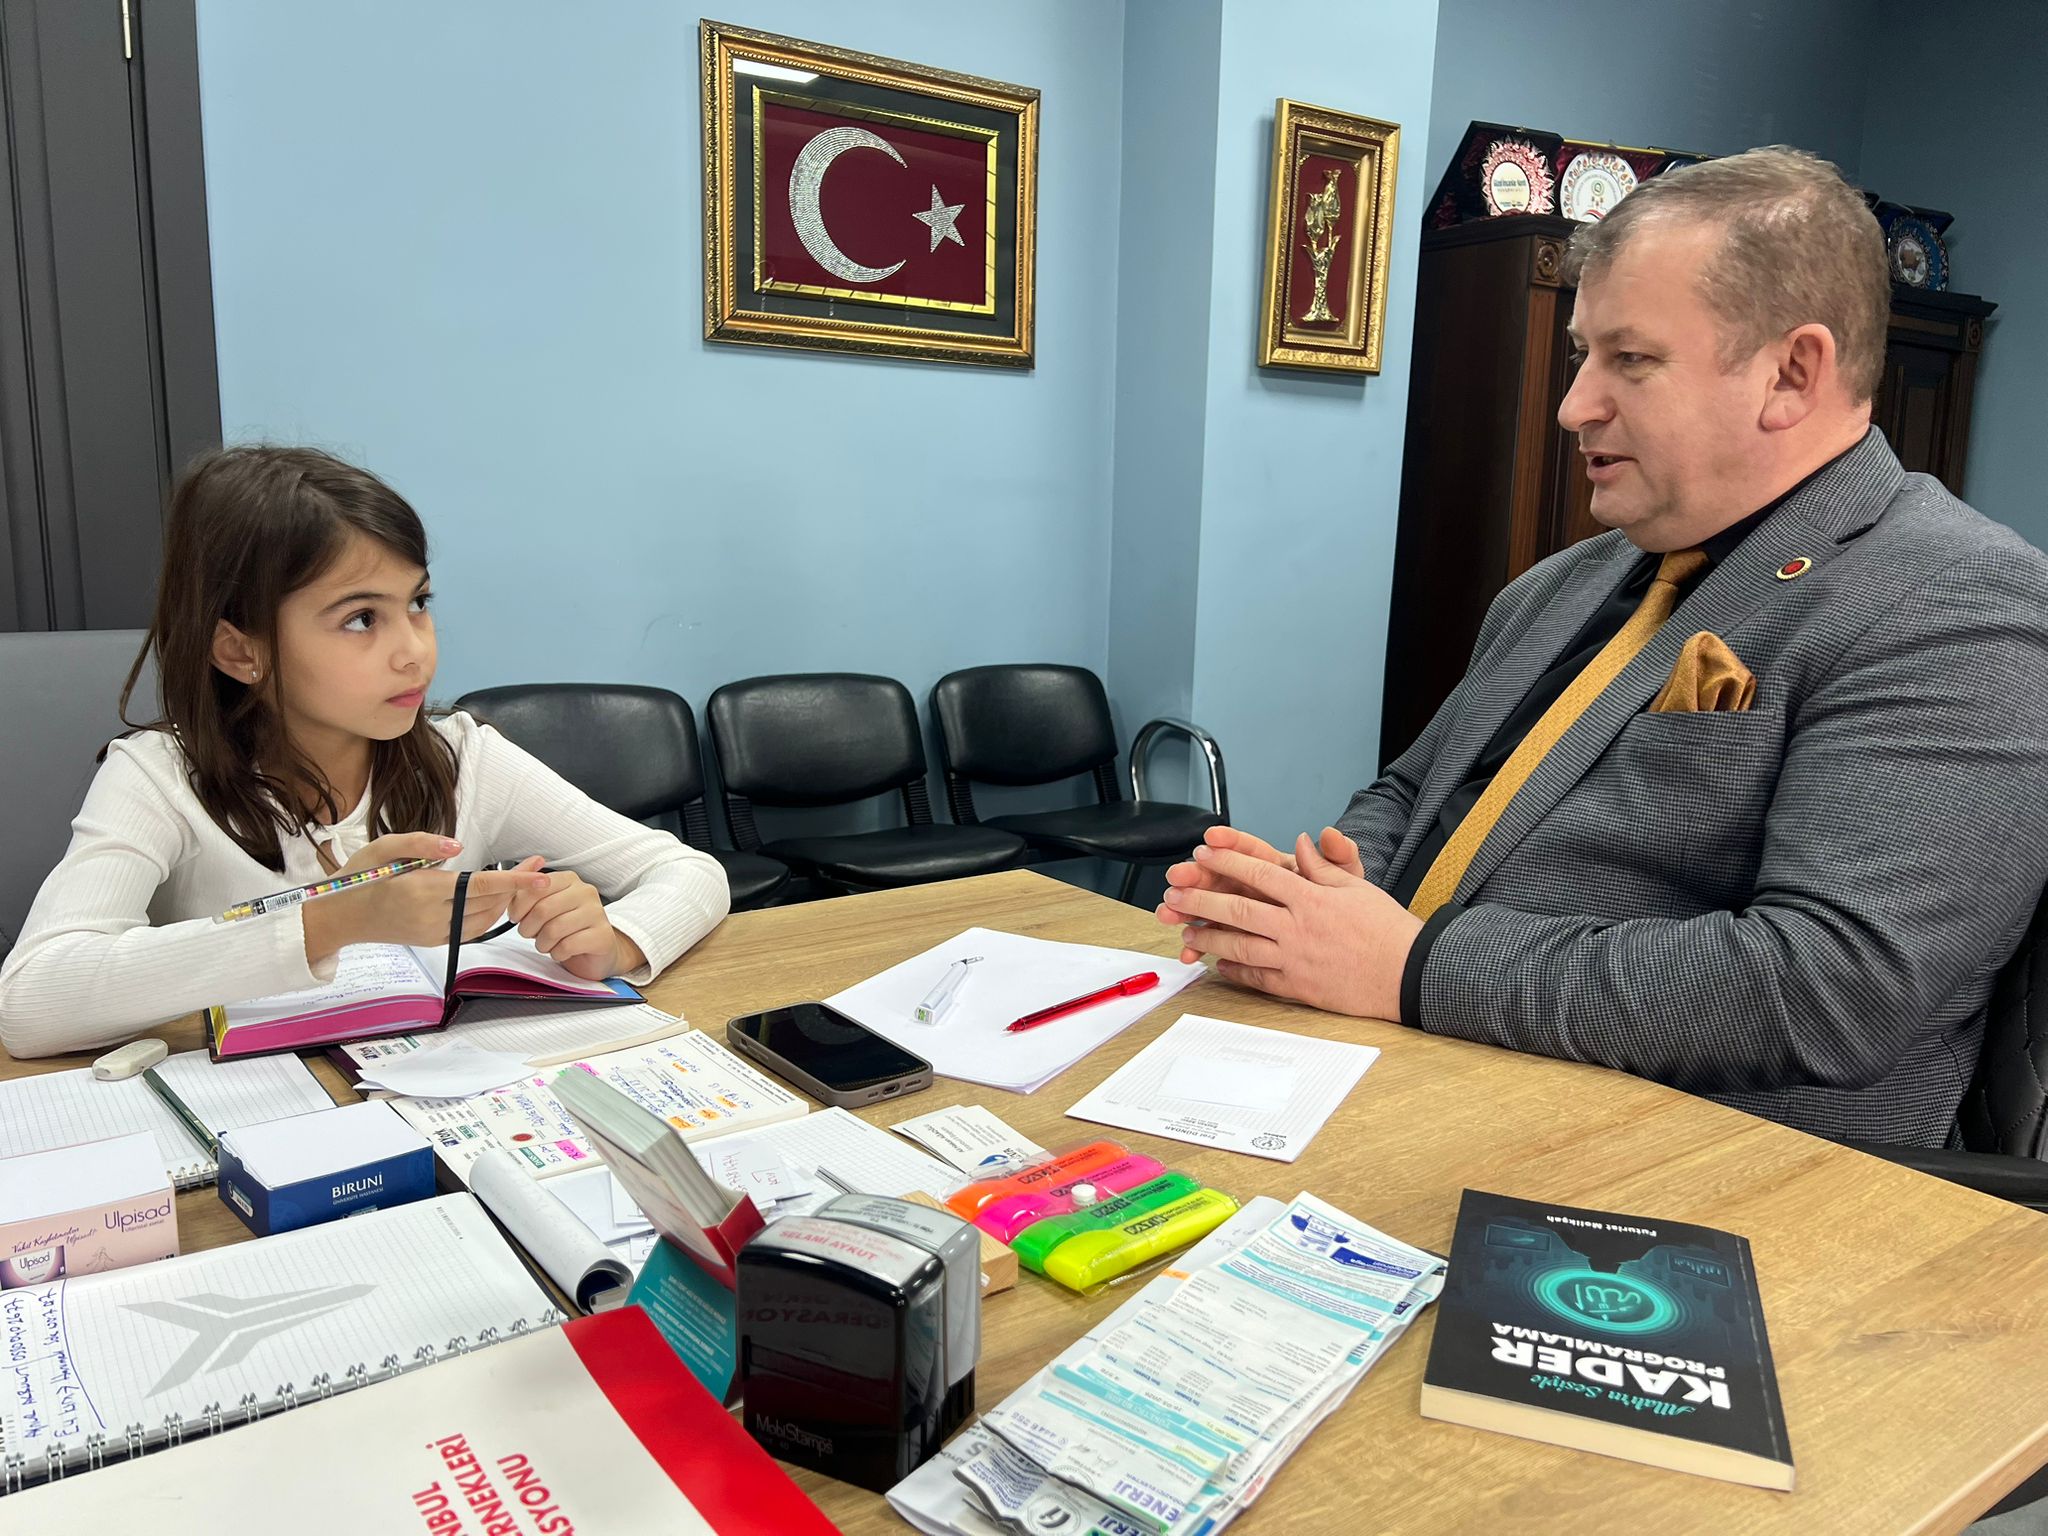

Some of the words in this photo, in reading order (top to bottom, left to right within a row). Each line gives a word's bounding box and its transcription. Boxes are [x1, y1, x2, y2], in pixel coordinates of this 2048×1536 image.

[332, 1172, 383, 1198] BİRUNİ
[104, 1198, 171, 1233] Ulpisad
[19, 1252, 50, 1271] Ulpisad
[779, 1229, 828, 1247] SELAMİ
[829, 1240, 877, 1260] AYKUT
[1490, 1336, 1733, 1410] KADER
[1491, 1321, 1726, 1380] PROGRAMLAMA
[1530, 1374, 1603, 1401] Sesiyle
[756, 1412, 833, 1457] MobiStamps
[426, 1433, 523, 1536] RNEKLERİ
[1114, 1478, 1182, 1523] ENERJİ
[412, 1480, 469, 1536] NBUL
